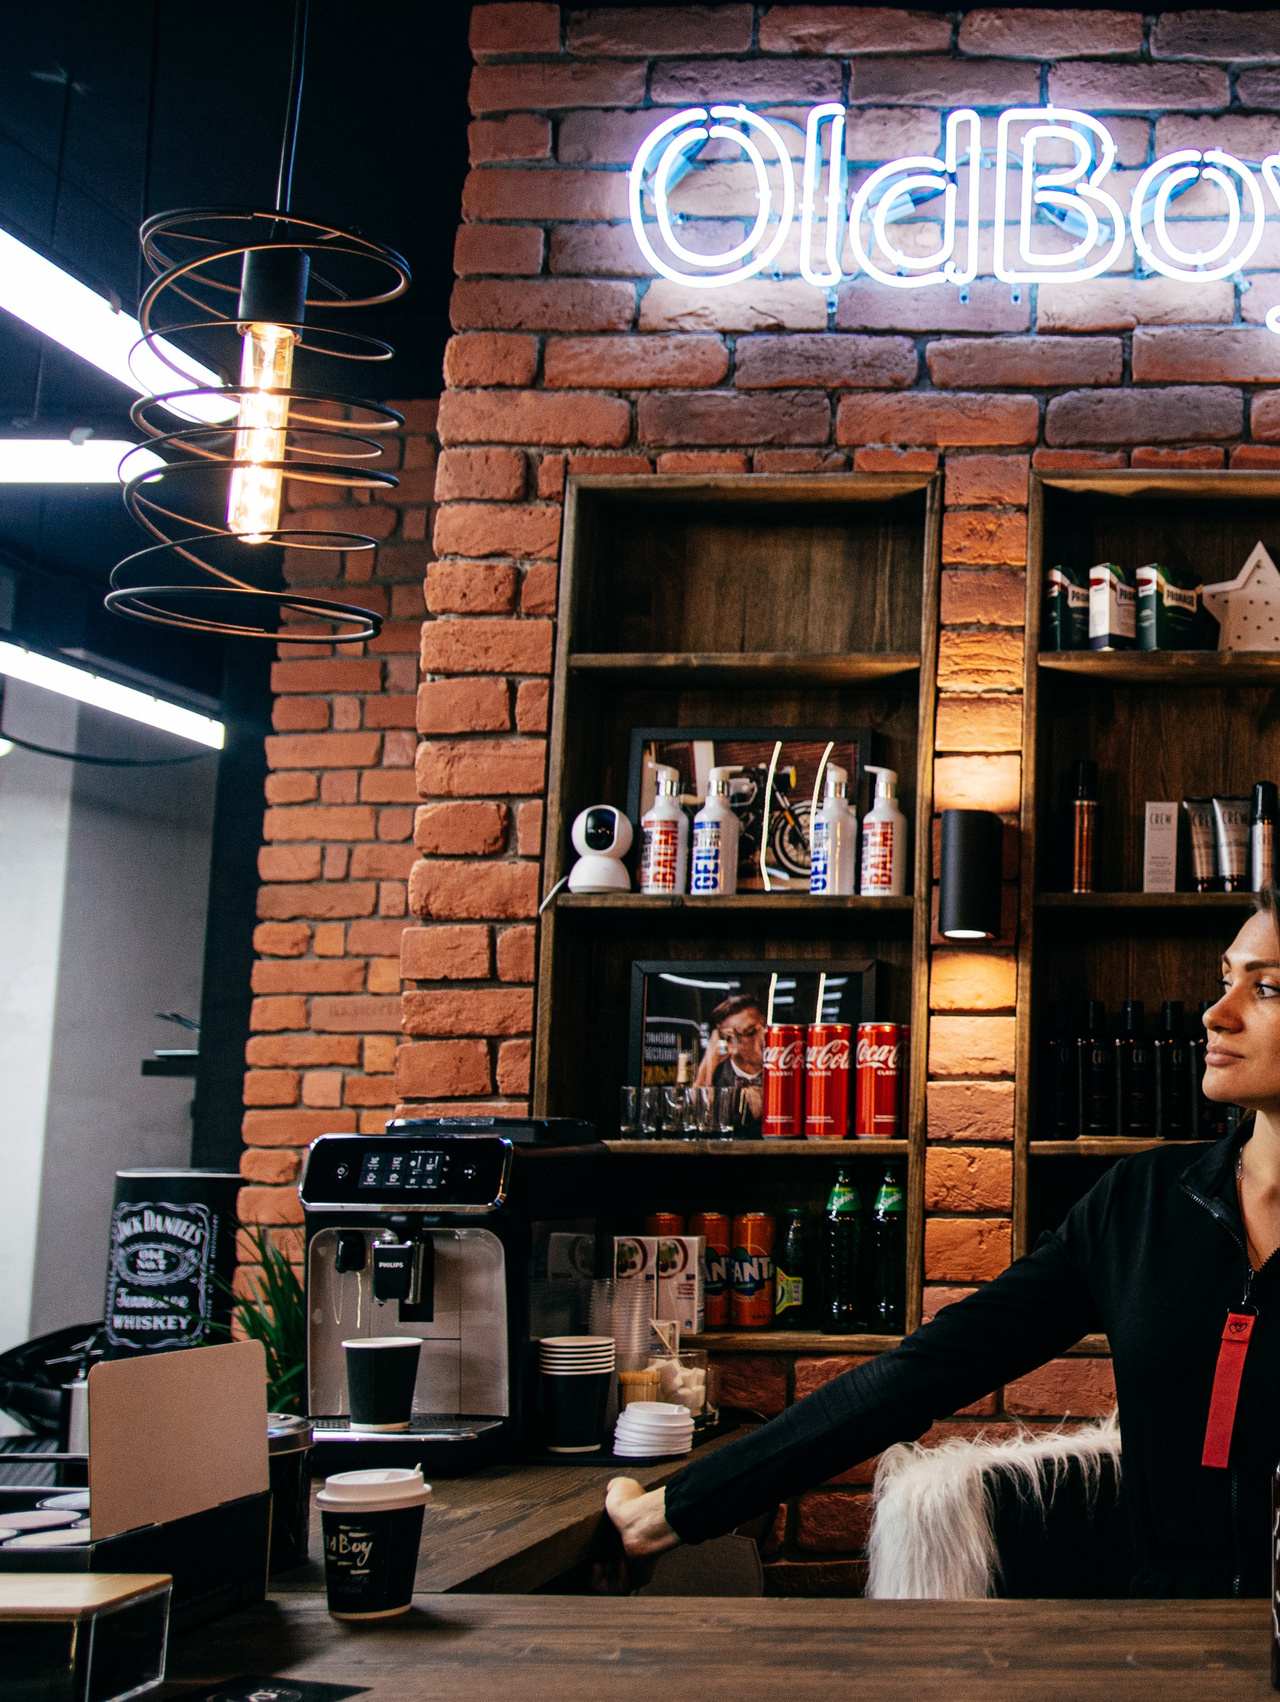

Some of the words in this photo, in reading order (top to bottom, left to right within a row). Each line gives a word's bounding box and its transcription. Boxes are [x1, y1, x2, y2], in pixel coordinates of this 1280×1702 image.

[1150, 812, 1172, 825] CREW
[653, 829, 678, 883] BALM
[870, 831, 892, 885] BALM
[112, 1315, 192, 1331] WHISKEY
[325, 1533, 373, 1567] ldBoy
